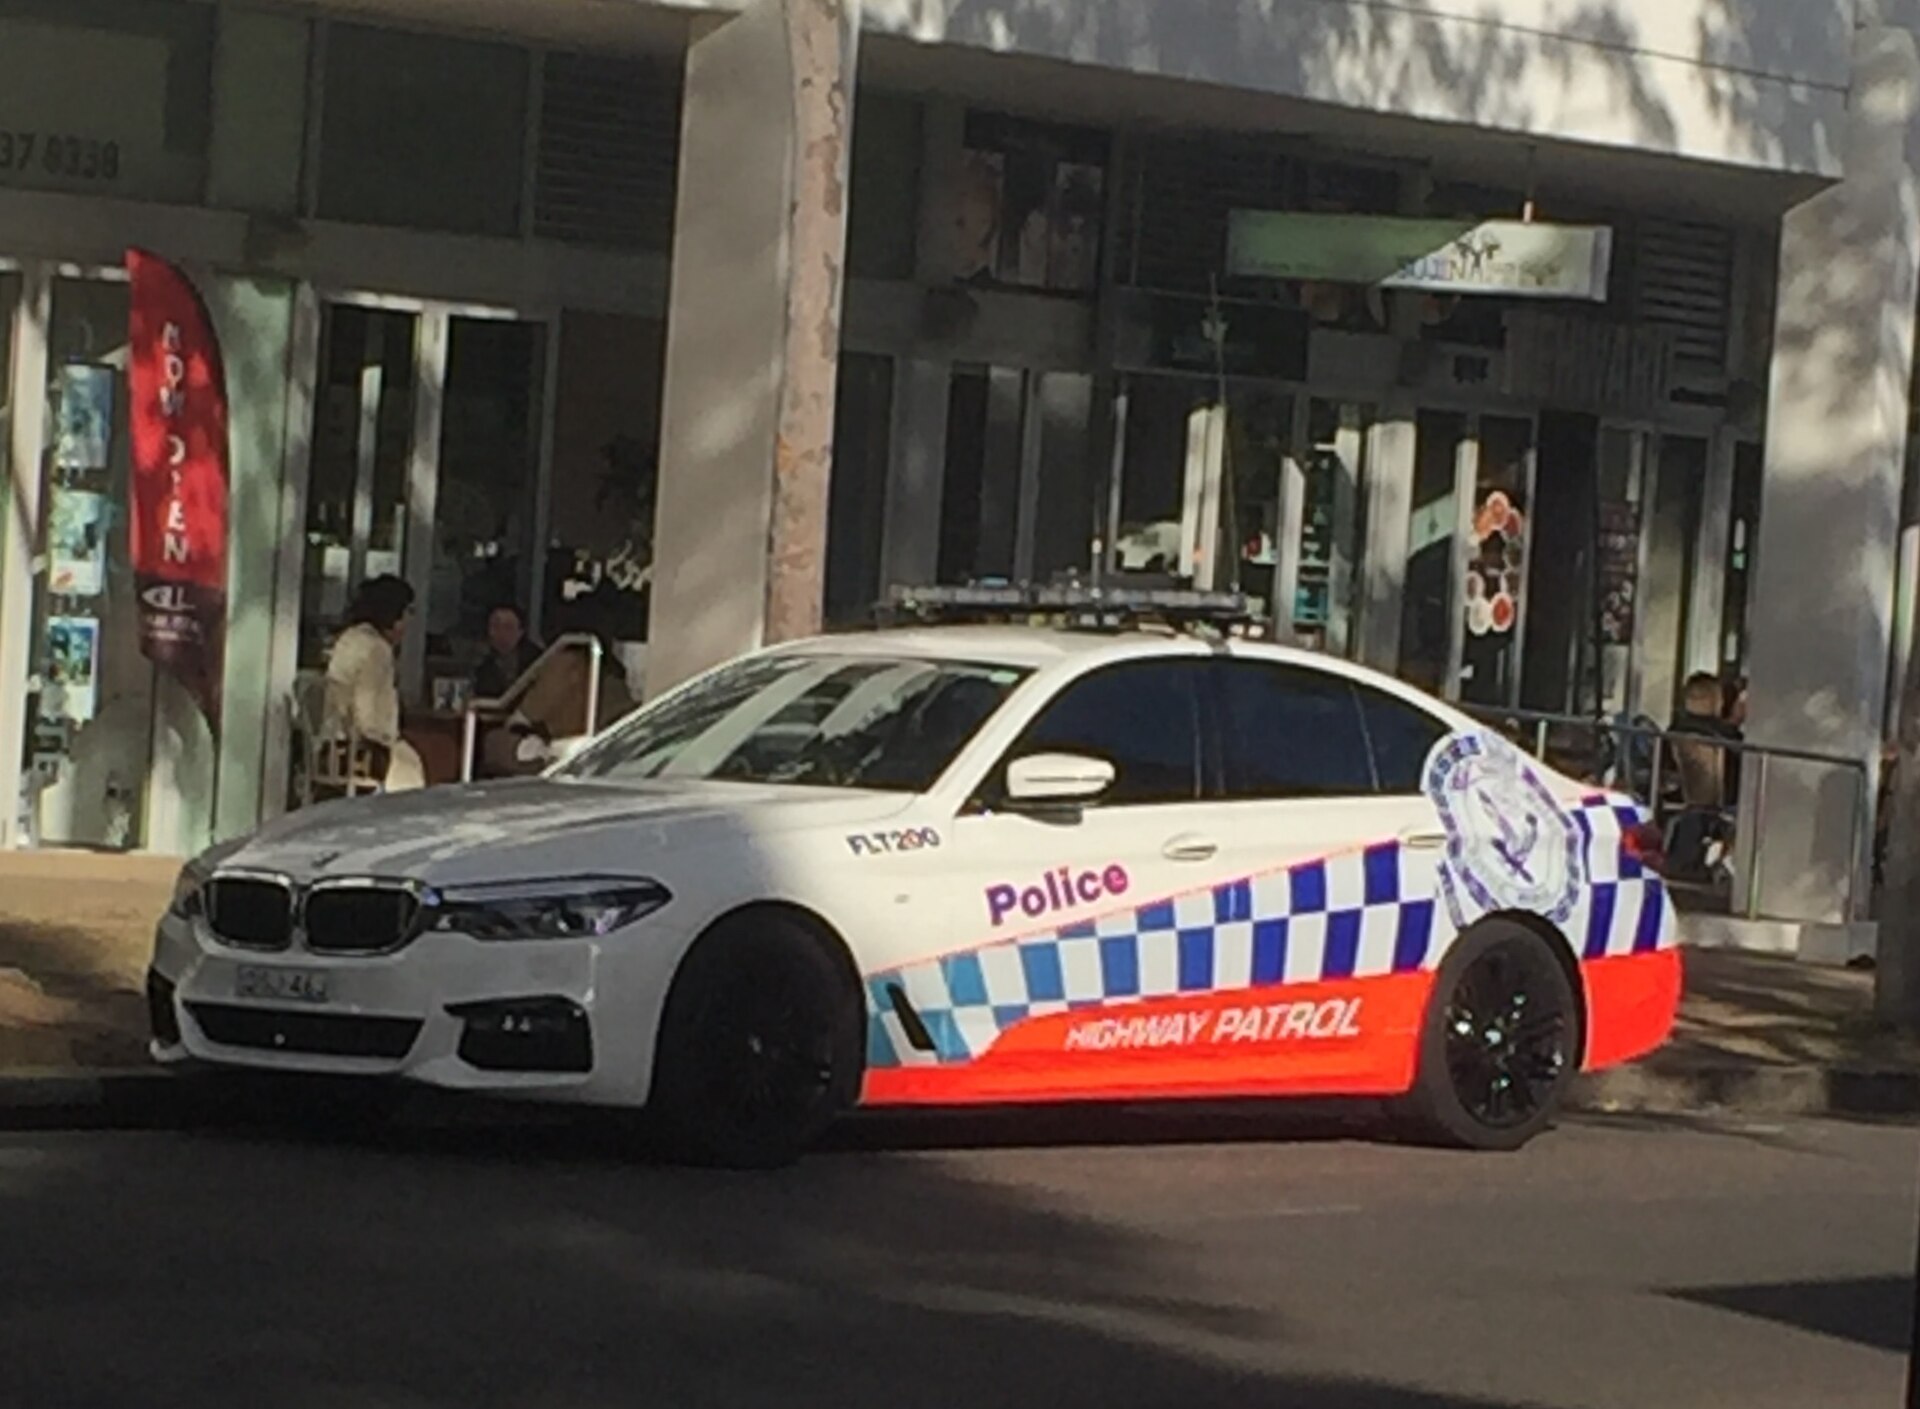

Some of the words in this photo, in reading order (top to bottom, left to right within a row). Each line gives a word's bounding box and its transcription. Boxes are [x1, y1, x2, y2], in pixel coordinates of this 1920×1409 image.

[985, 864, 1128, 927] Police
[1065, 1009, 1213, 1051] HIGHWAY
[1211, 998, 1362, 1043] PATROL
